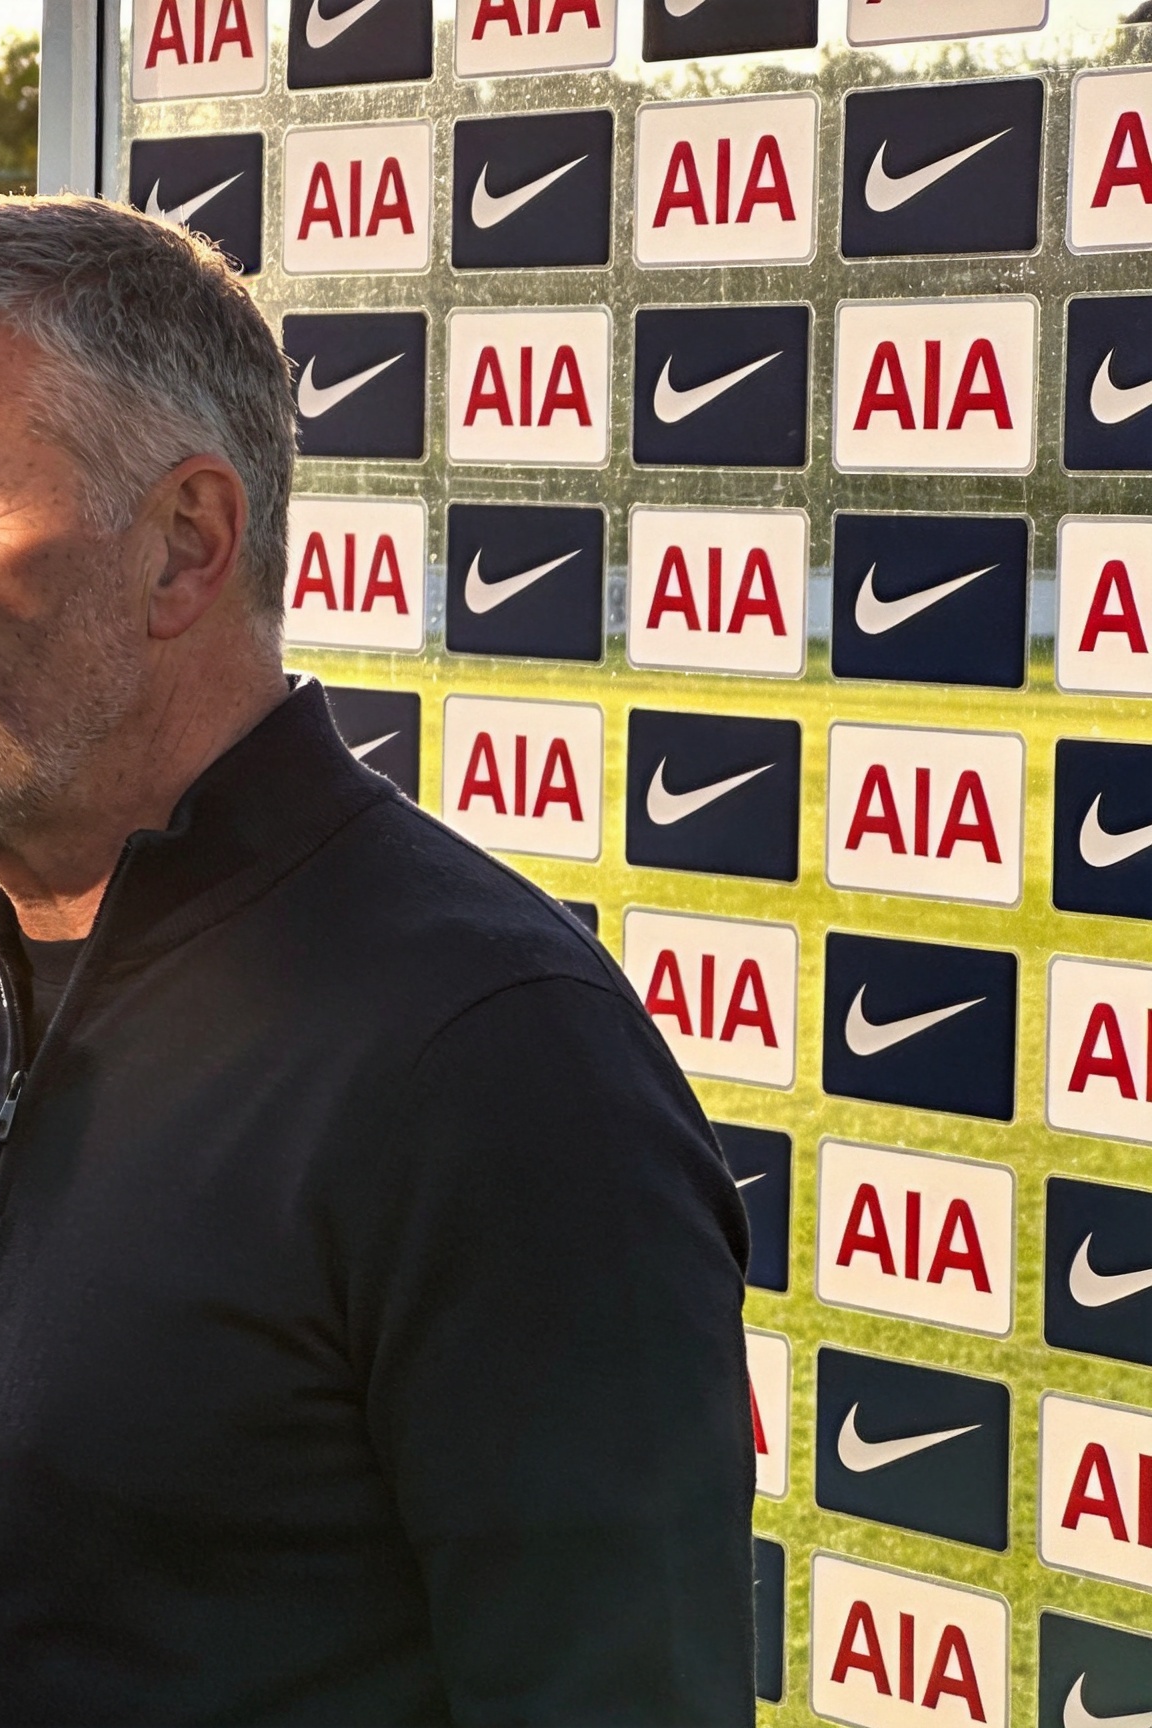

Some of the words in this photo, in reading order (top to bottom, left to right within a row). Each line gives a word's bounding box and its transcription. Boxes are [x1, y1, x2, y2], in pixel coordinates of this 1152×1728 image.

[146, 0, 252, 68] AIA
[298, 157, 414, 241] AIA
[653, 135, 795, 228] AIA
[464, 345, 592, 428] AIA
[854, 338, 1013, 431] AIA
[292, 531, 408, 615] AIA
[647, 546, 787, 637] AIA
[1078, 559, 1148, 654] A
[458, 731, 583, 822] AIA
[846, 763, 1001, 864] AIA
[645, 948, 778, 1048] AIA
[1068, 1002, 1152, 1103] A
[837, 1184, 990, 1294] AIA
[831, 1600, 984, 1722] AIA
